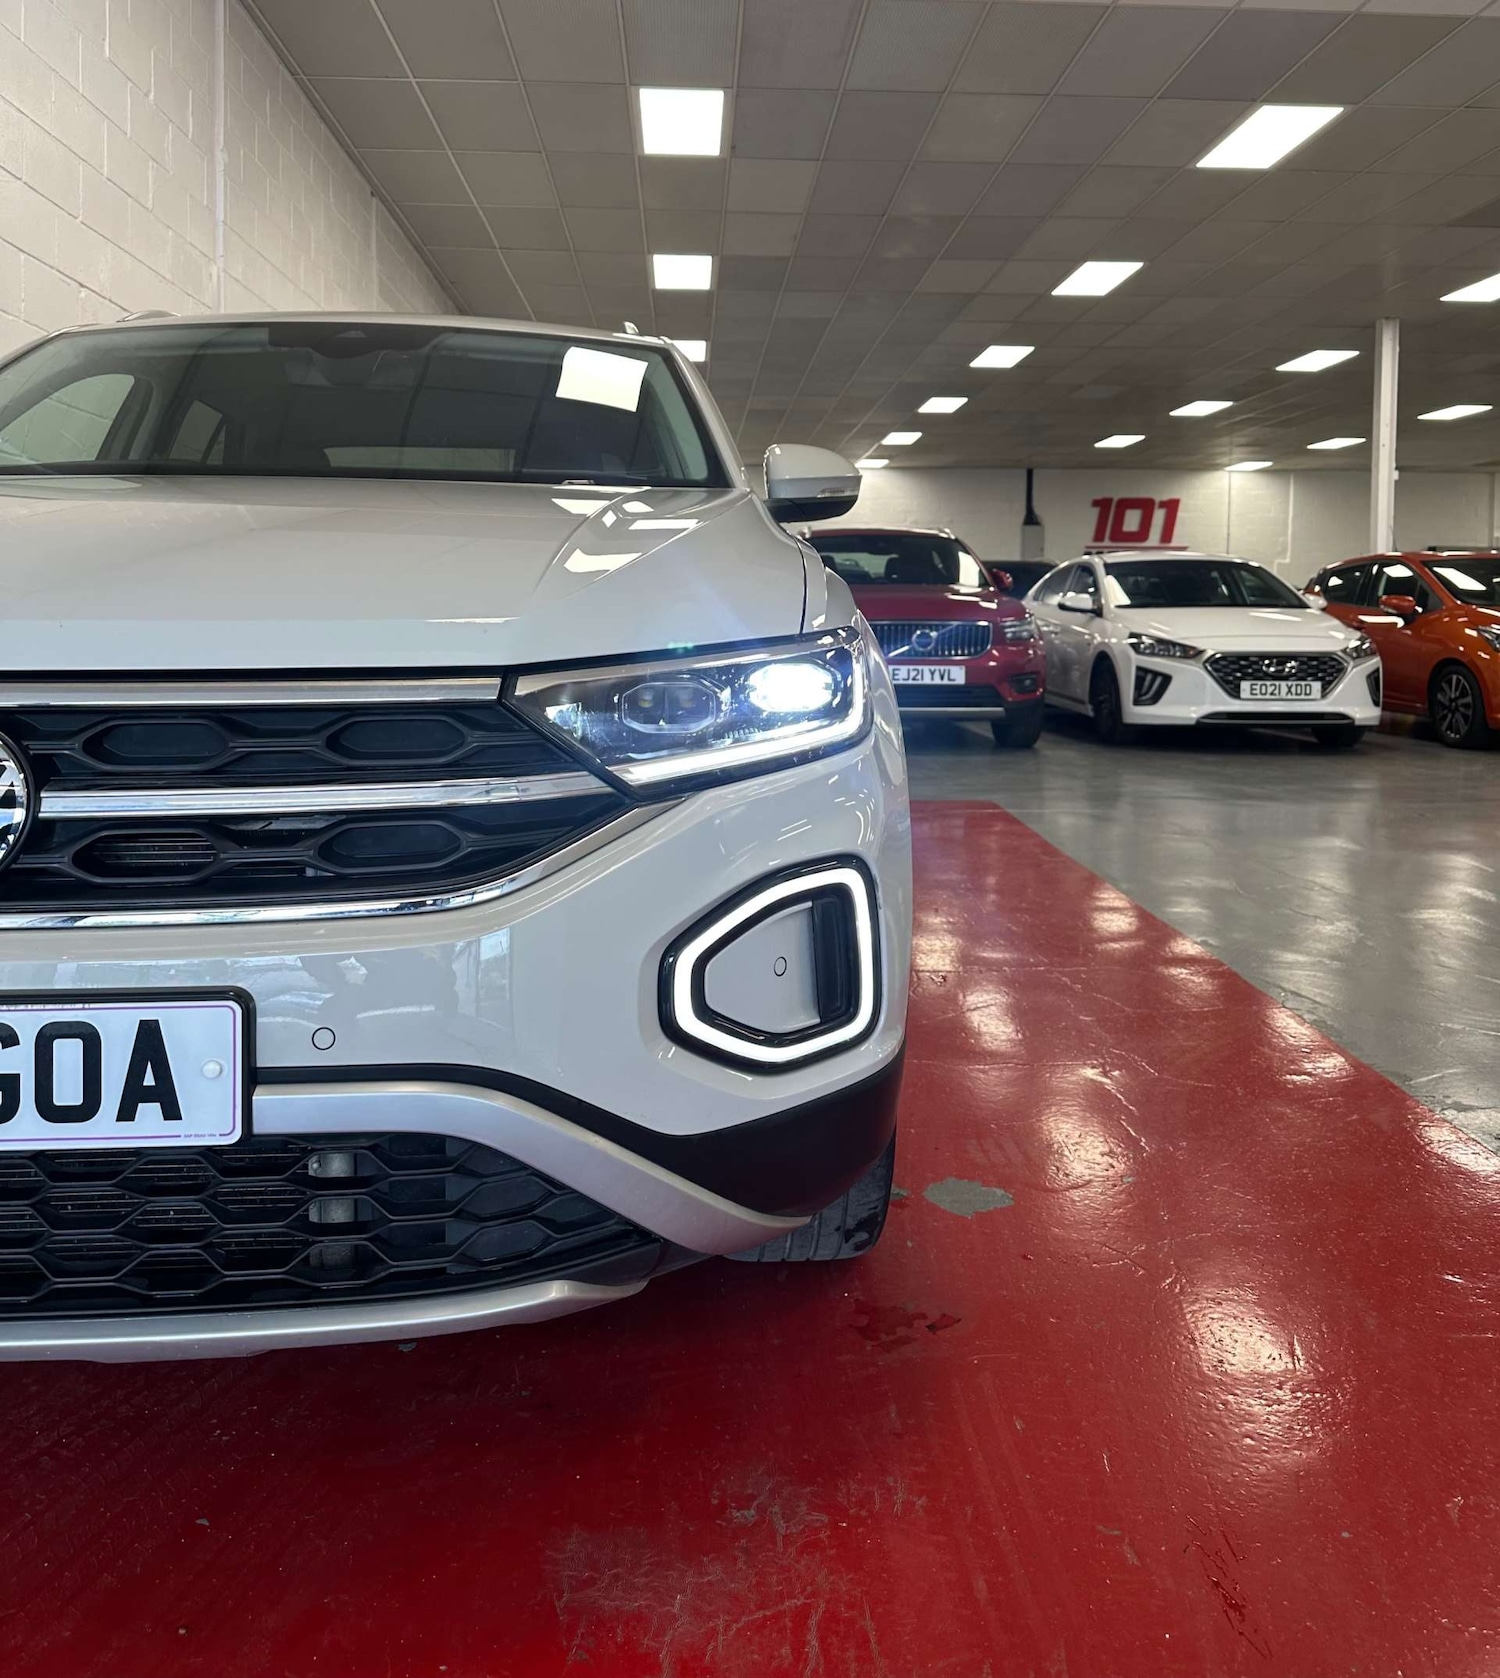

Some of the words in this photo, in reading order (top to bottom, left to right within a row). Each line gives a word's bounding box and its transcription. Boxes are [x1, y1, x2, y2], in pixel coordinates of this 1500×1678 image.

[1091, 497, 1181, 544] 101
[892, 668, 924, 681] EJ21
[928, 668, 956, 681] YVL
[1249, 683, 1281, 696] EO21
[1285, 683, 1312, 696] XDD
